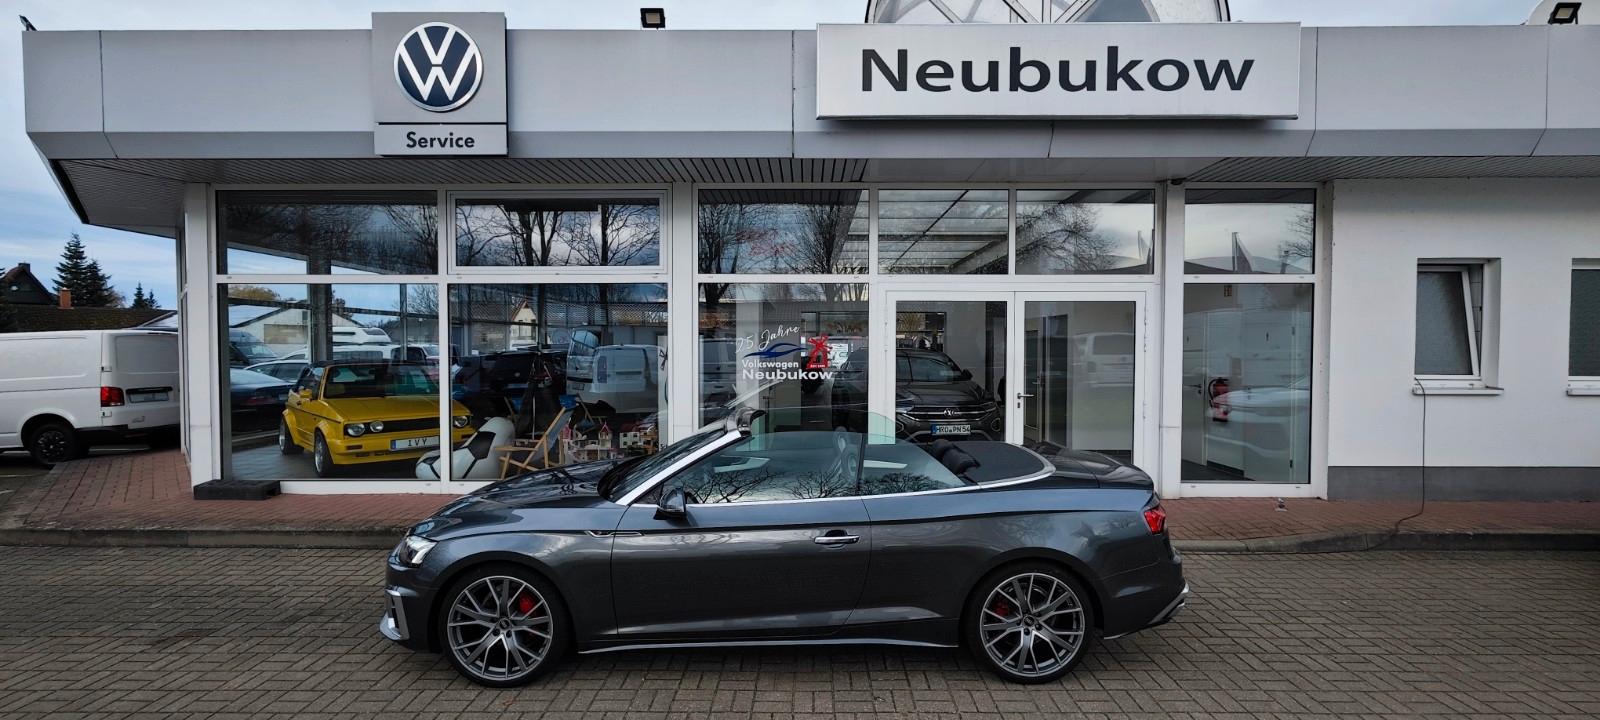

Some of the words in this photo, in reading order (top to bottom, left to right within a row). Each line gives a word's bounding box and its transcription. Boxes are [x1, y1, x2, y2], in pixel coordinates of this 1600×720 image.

[862, 46, 1255, 92] Neubukow
[406, 131, 475, 148] Service
[759, 325, 800, 351] Jahre
[742, 359, 799, 369] Volkswagen
[742, 369, 832, 380] Neubukow
[408, 438, 427, 446] IVY
